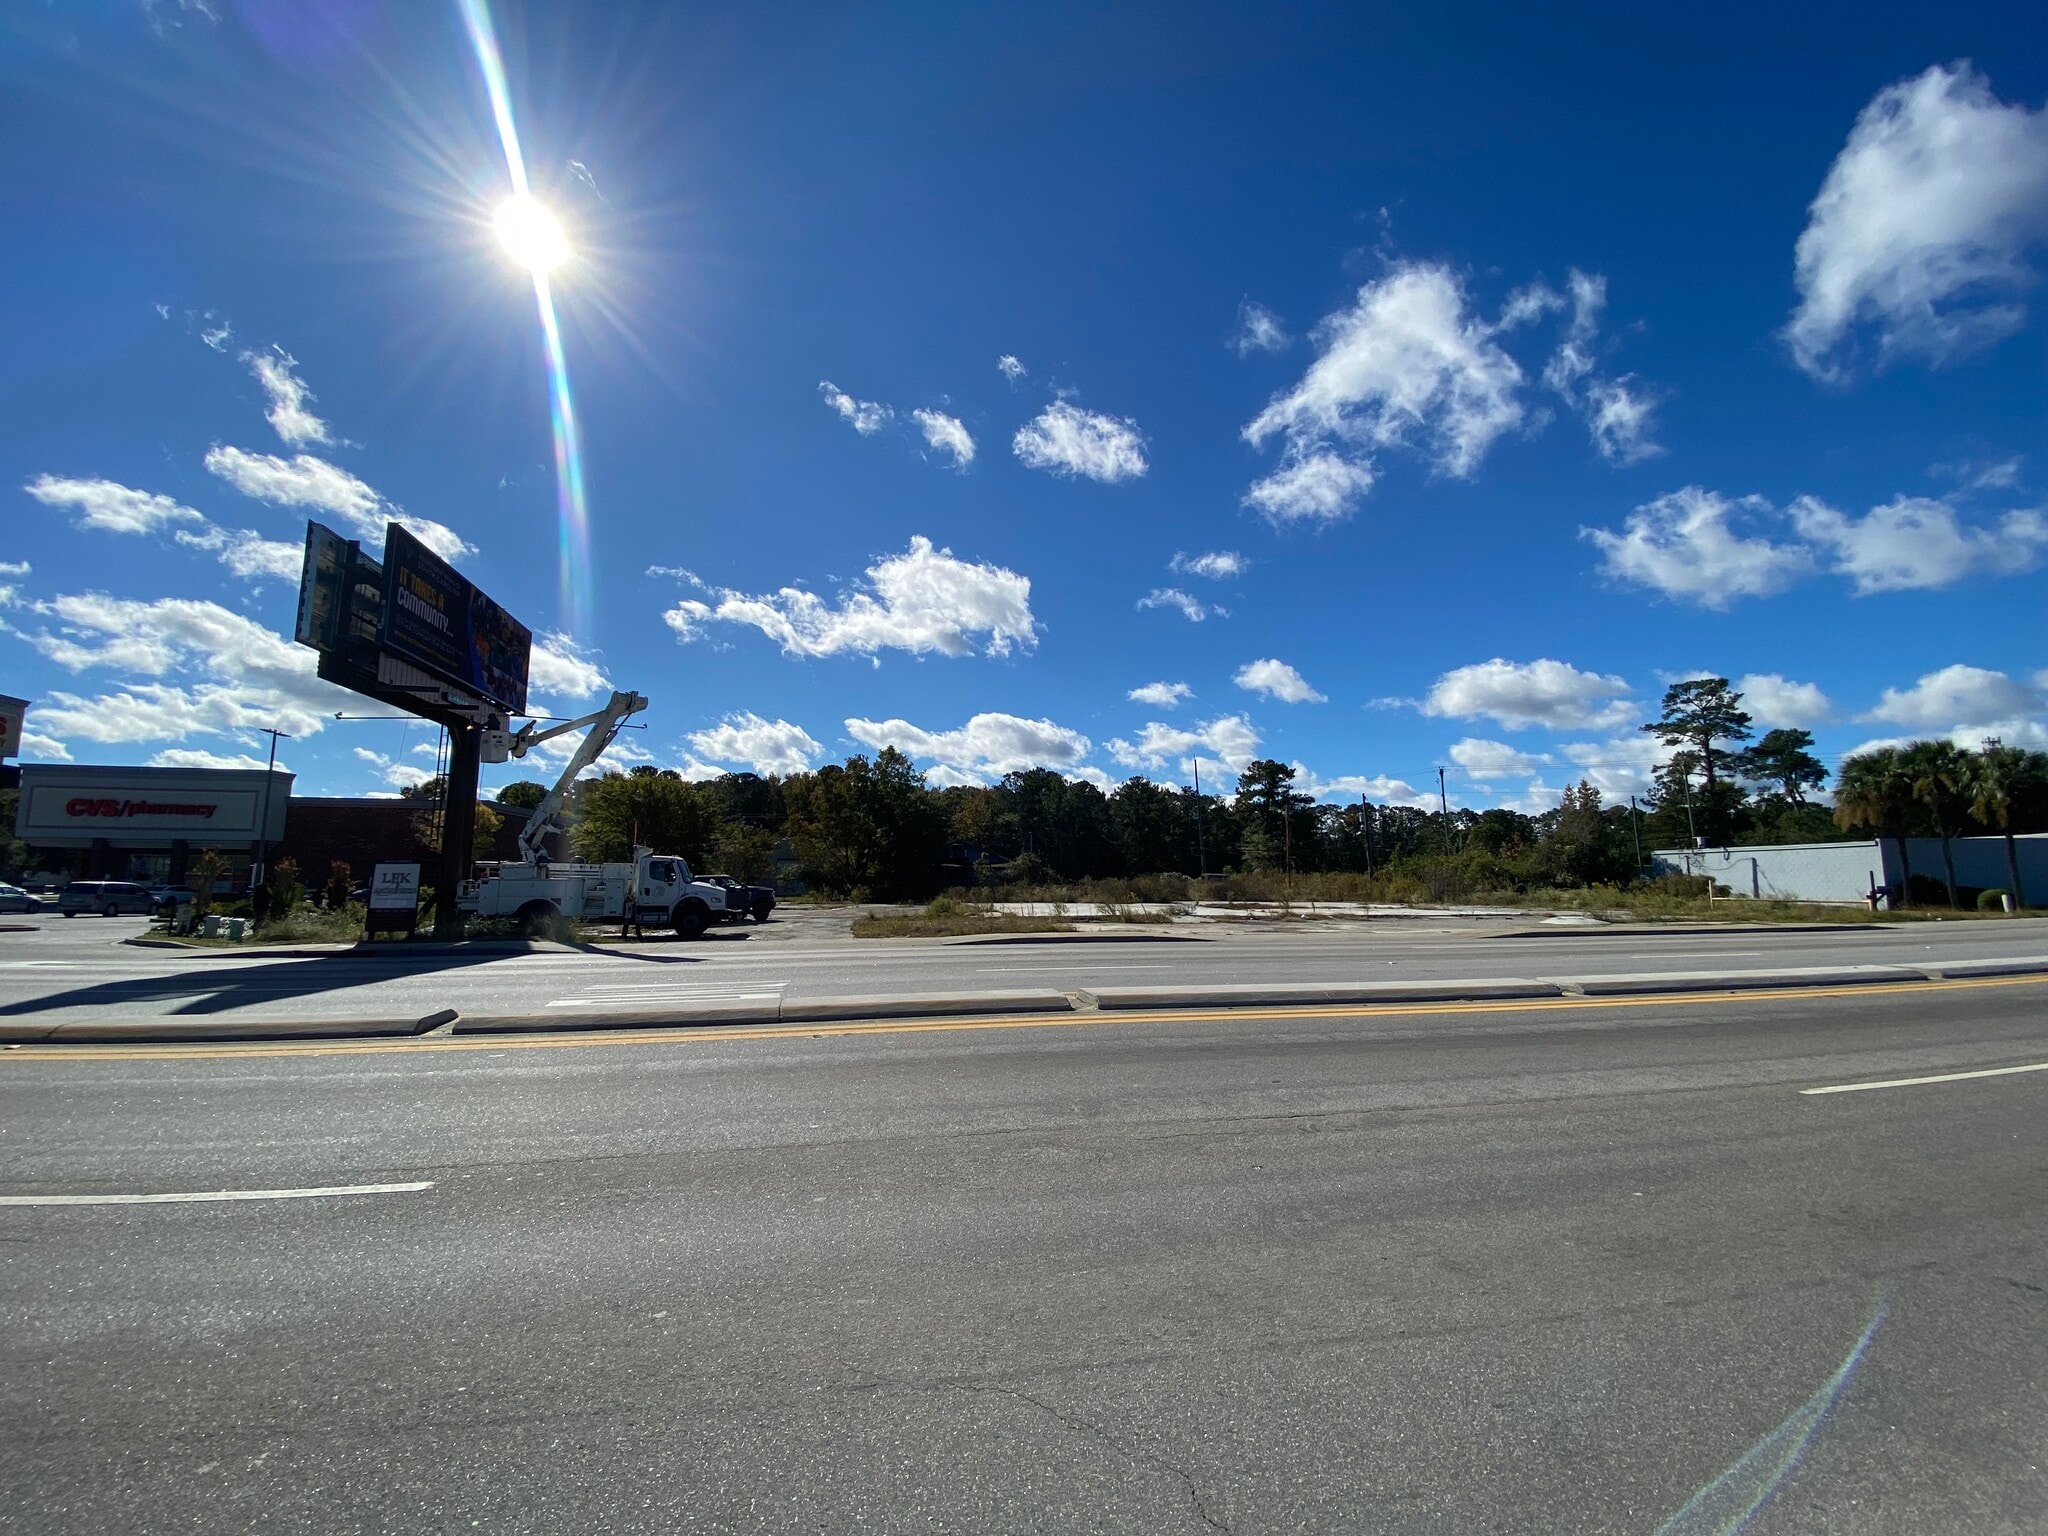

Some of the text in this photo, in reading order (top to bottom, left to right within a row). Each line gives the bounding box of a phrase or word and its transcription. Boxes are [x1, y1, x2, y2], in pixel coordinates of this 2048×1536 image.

[399, 565, 409, 587] IT
[411, 573, 437, 606] TAKES
[438, 593, 445, 611] A
